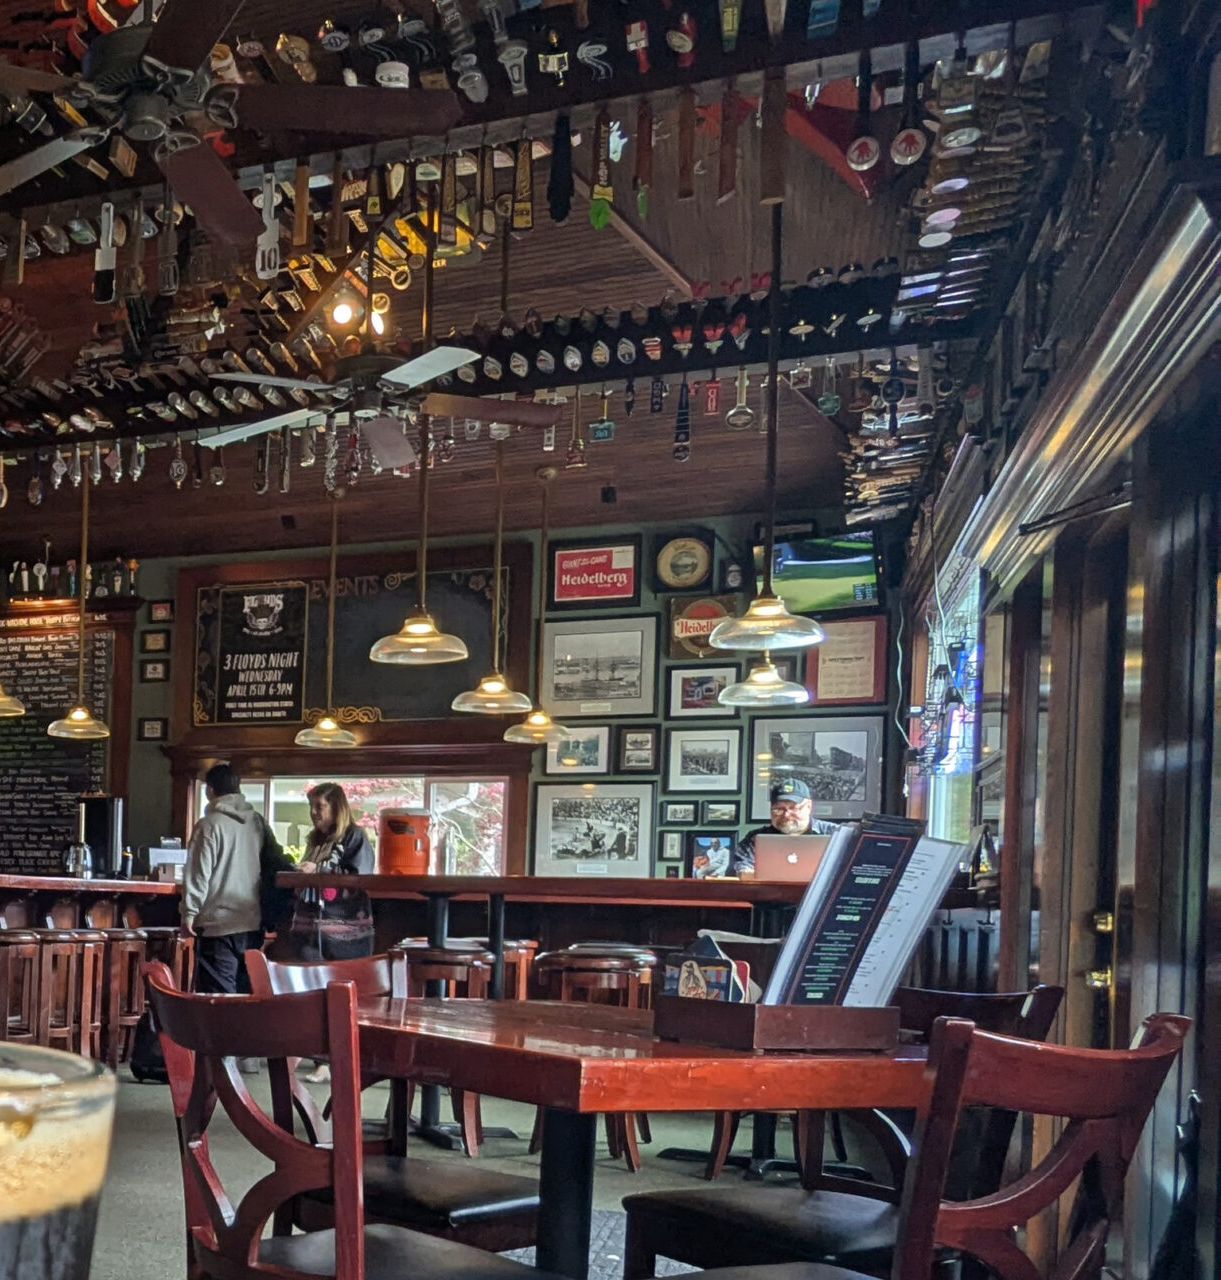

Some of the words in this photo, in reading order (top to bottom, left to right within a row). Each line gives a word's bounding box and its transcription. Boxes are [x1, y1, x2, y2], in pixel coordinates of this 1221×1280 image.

[311, 575, 378, 599] EVENTS
[561, 572, 627, 587] Heidelberg
[223, 653, 232, 670] 3
[233, 652, 267, 670] FLOYDS
[268, 651, 299, 669] NIGHT
[238, 670, 284, 683] WEDNESDAY
[227, 684, 248, 697] APRIL
